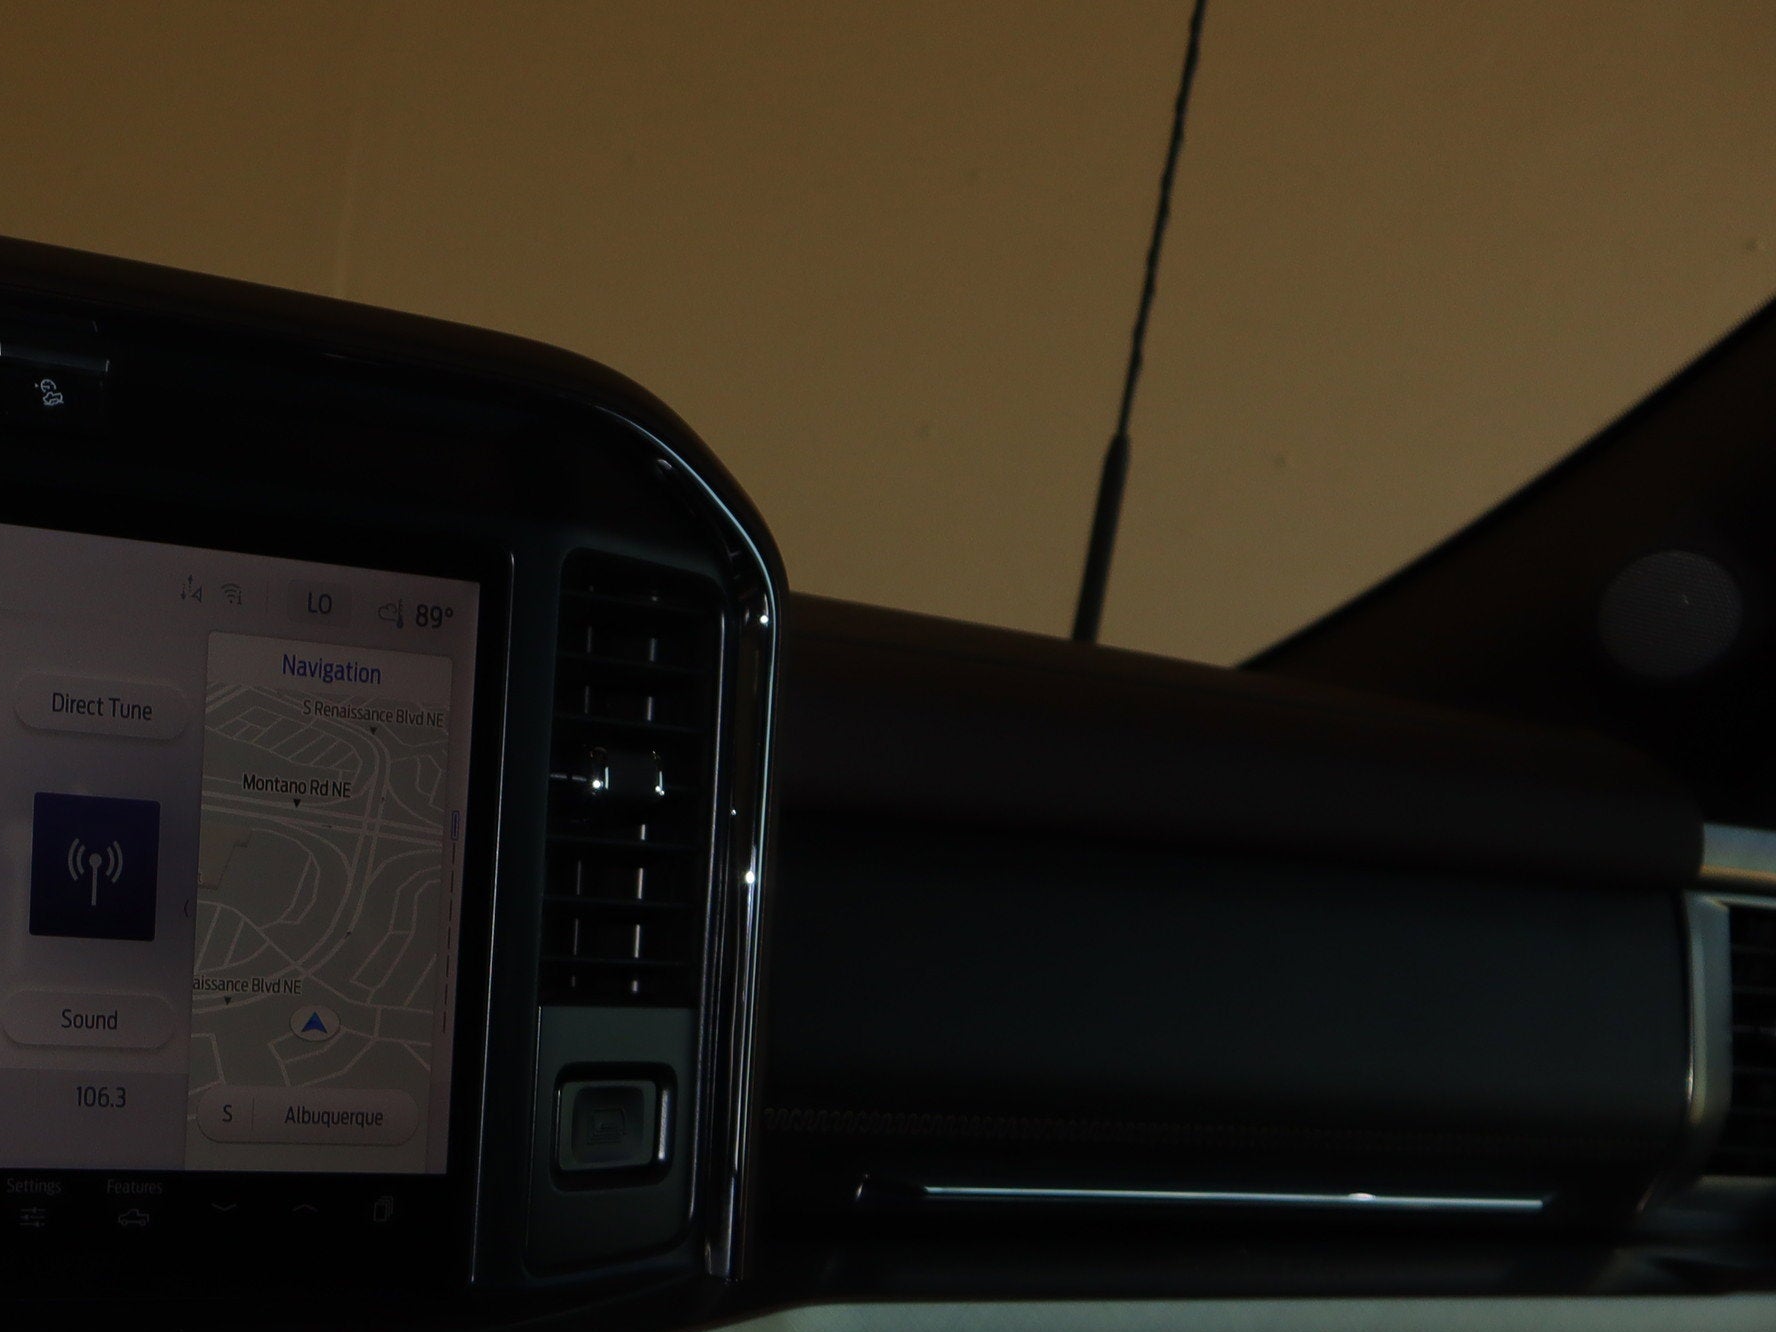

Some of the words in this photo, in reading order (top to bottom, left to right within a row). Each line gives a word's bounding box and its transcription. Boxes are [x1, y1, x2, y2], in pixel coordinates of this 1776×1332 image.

[308, 592, 332, 614] LO
[415, 604, 454, 629] 89°
[282, 654, 382, 684] Navigation
[52, 692, 104, 717] Direct
[109, 697, 153, 721] Tune
[303, 700, 312, 715] S
[314, 701, 393, 722] Renaissance
[396, 709, 424, 725] Blvd
[426, 712, 444, 727] NE
[243, 774, 307, 795] Montano
[310, 779, 329, 796] Rd
[332, 782, 352, 798] NE
[252, 977, 281, 994] Blvd
[283, 979, 302, 995] NE
[61, 1008, 118, 1030] Sound
[76, 1086, 126, 1108] 106.3
[222, 1104, 233, 1122] S
[284, 1106, 383, 1127] Albuquerque
[6, 1178, 63, 1195] Settings
[106, 1178, 163, 1194] Features
